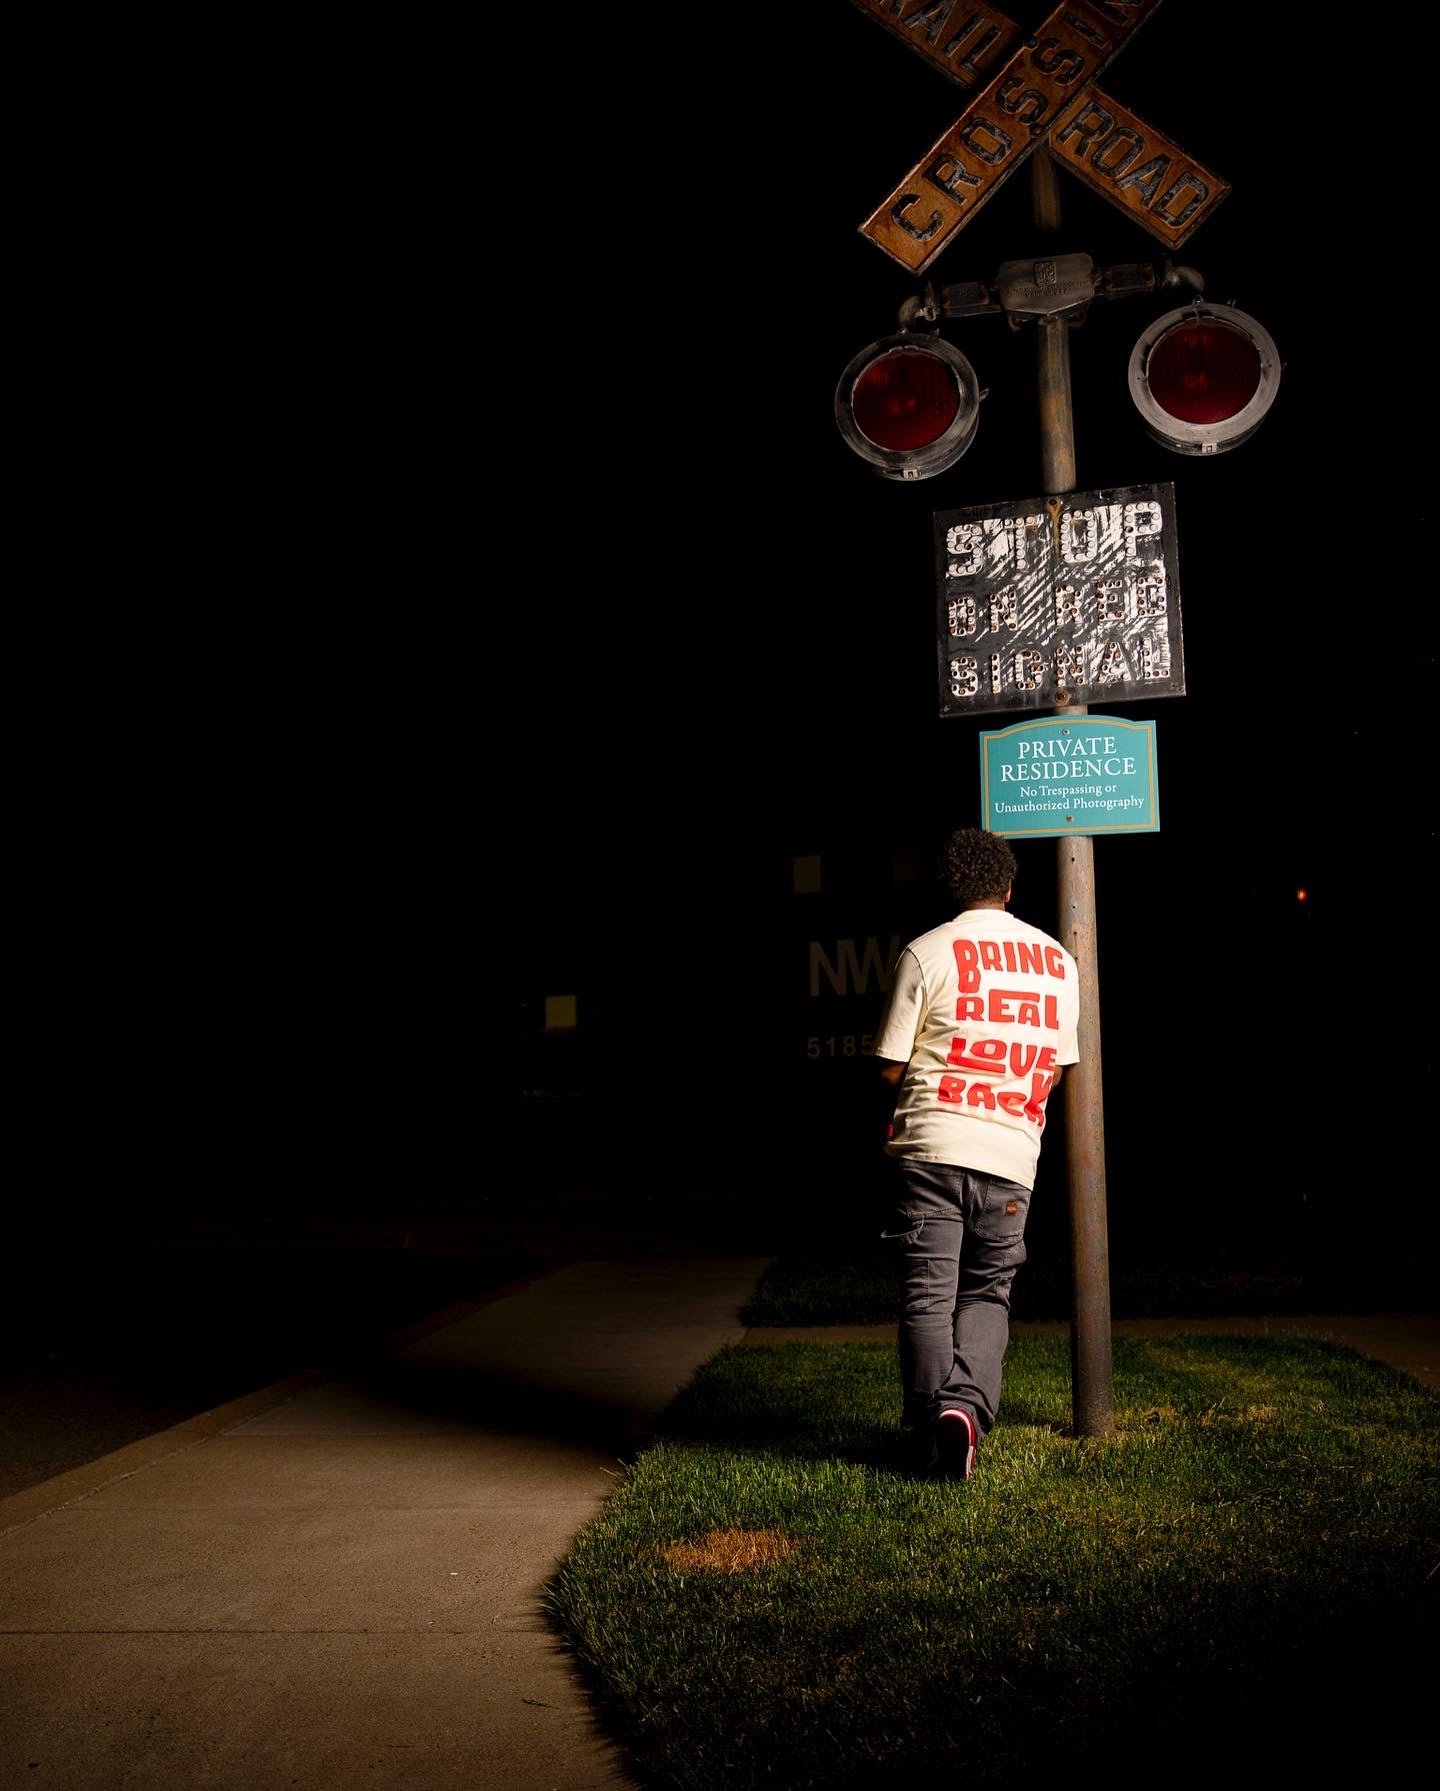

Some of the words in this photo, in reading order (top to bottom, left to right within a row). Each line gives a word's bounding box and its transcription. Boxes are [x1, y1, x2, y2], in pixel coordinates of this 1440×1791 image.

[878, 0, 1002, 76] AIL
[1056, 100, 1209, 228] ROAD
[945, 501, 1163, 577] STOP
[948, 590, 1018, 637] ON
[1053, 577, 1168, 625] RED
[950, 638, 1170, 697] SIGNAL
[1000, 757, 1136, 782] RESIDENCE
[1017, 736, 1117, 759] PRIVATE
[994, 798, 1070, 814] Unauthorized
[1073, 795, 1144, 810] Photography
[1019, 786, 1037, 797] No
[1039, 783, 1102, 797] Trespassing
[1104, 784, 1117, 793] or
[953, 939, 1065, 994] BRING
[955, 989, 1059, 1030] REAL
[946, 1037, 1057, 1078] LOVE
[937, 1072, 1054, 1127] BACK
